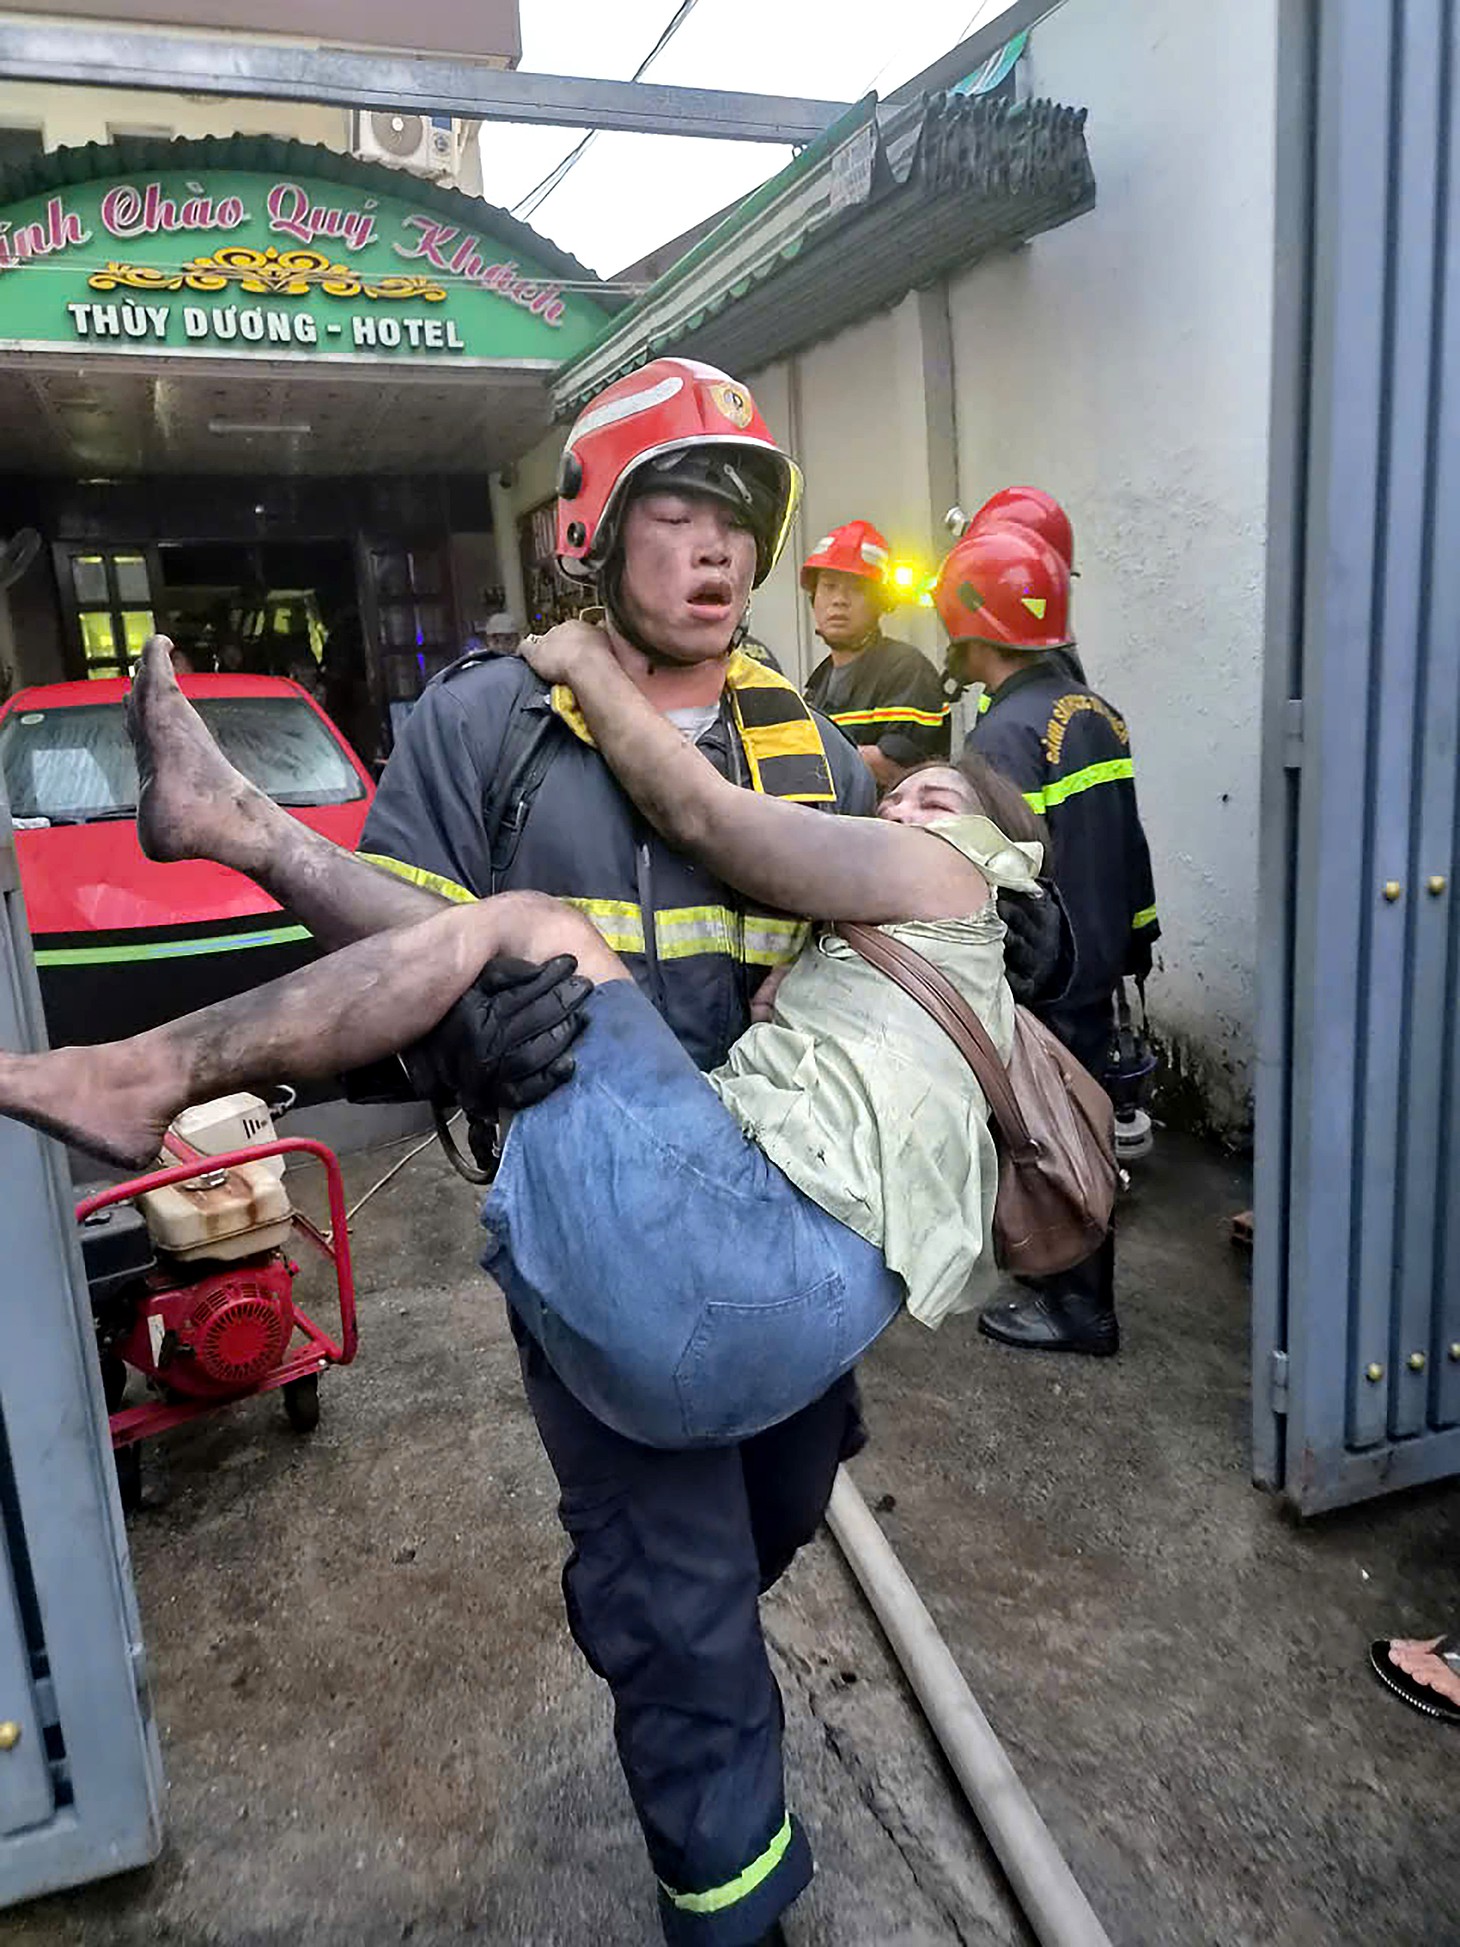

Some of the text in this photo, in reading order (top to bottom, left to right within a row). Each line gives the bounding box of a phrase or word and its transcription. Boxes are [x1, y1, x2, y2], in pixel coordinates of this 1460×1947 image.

[102, 182, 250, 237] Chào
[267, 183, 379, 250] Quý
[393, 214, 565, 327] Khách
[68, 298, 465, 348] THÙY DƯƠNG - HOTEL
